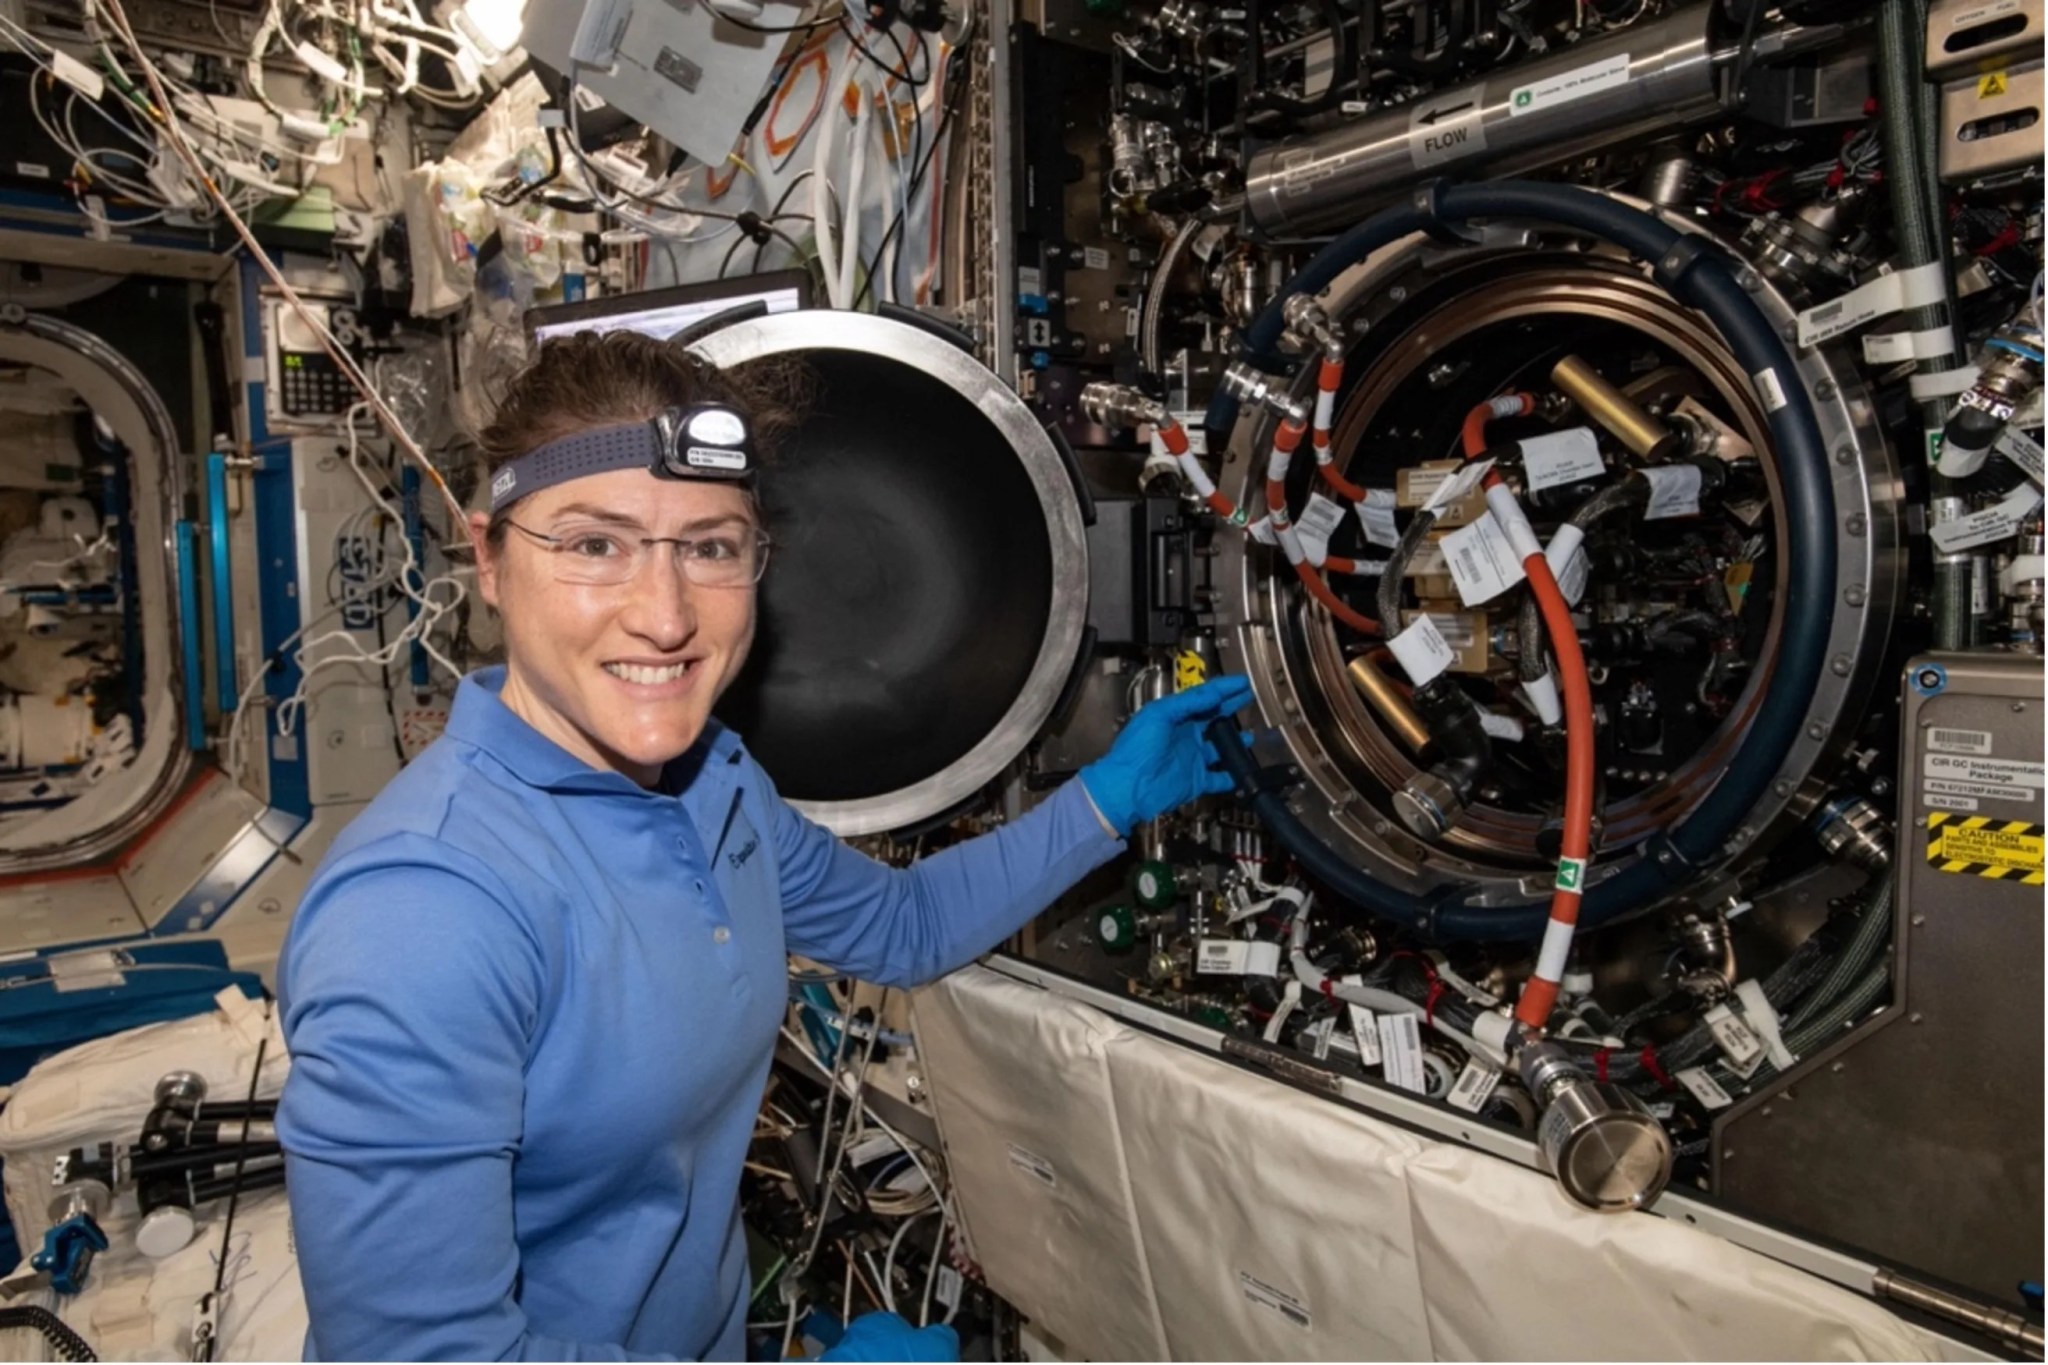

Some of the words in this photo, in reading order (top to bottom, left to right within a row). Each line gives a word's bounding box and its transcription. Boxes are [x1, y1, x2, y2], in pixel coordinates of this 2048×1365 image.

[1424, 127, 1468, 153] FLOW
[1931, 758, 1950, 767] CIR
[1952, 759, 1968, 768] GC
[1969, 771, 2014, 782] Package
[1945, 834, 1970, 844] PARTS
[1971, 838, 1988, 846] AND
[1959, 828, 2019, 843] CAUTION
